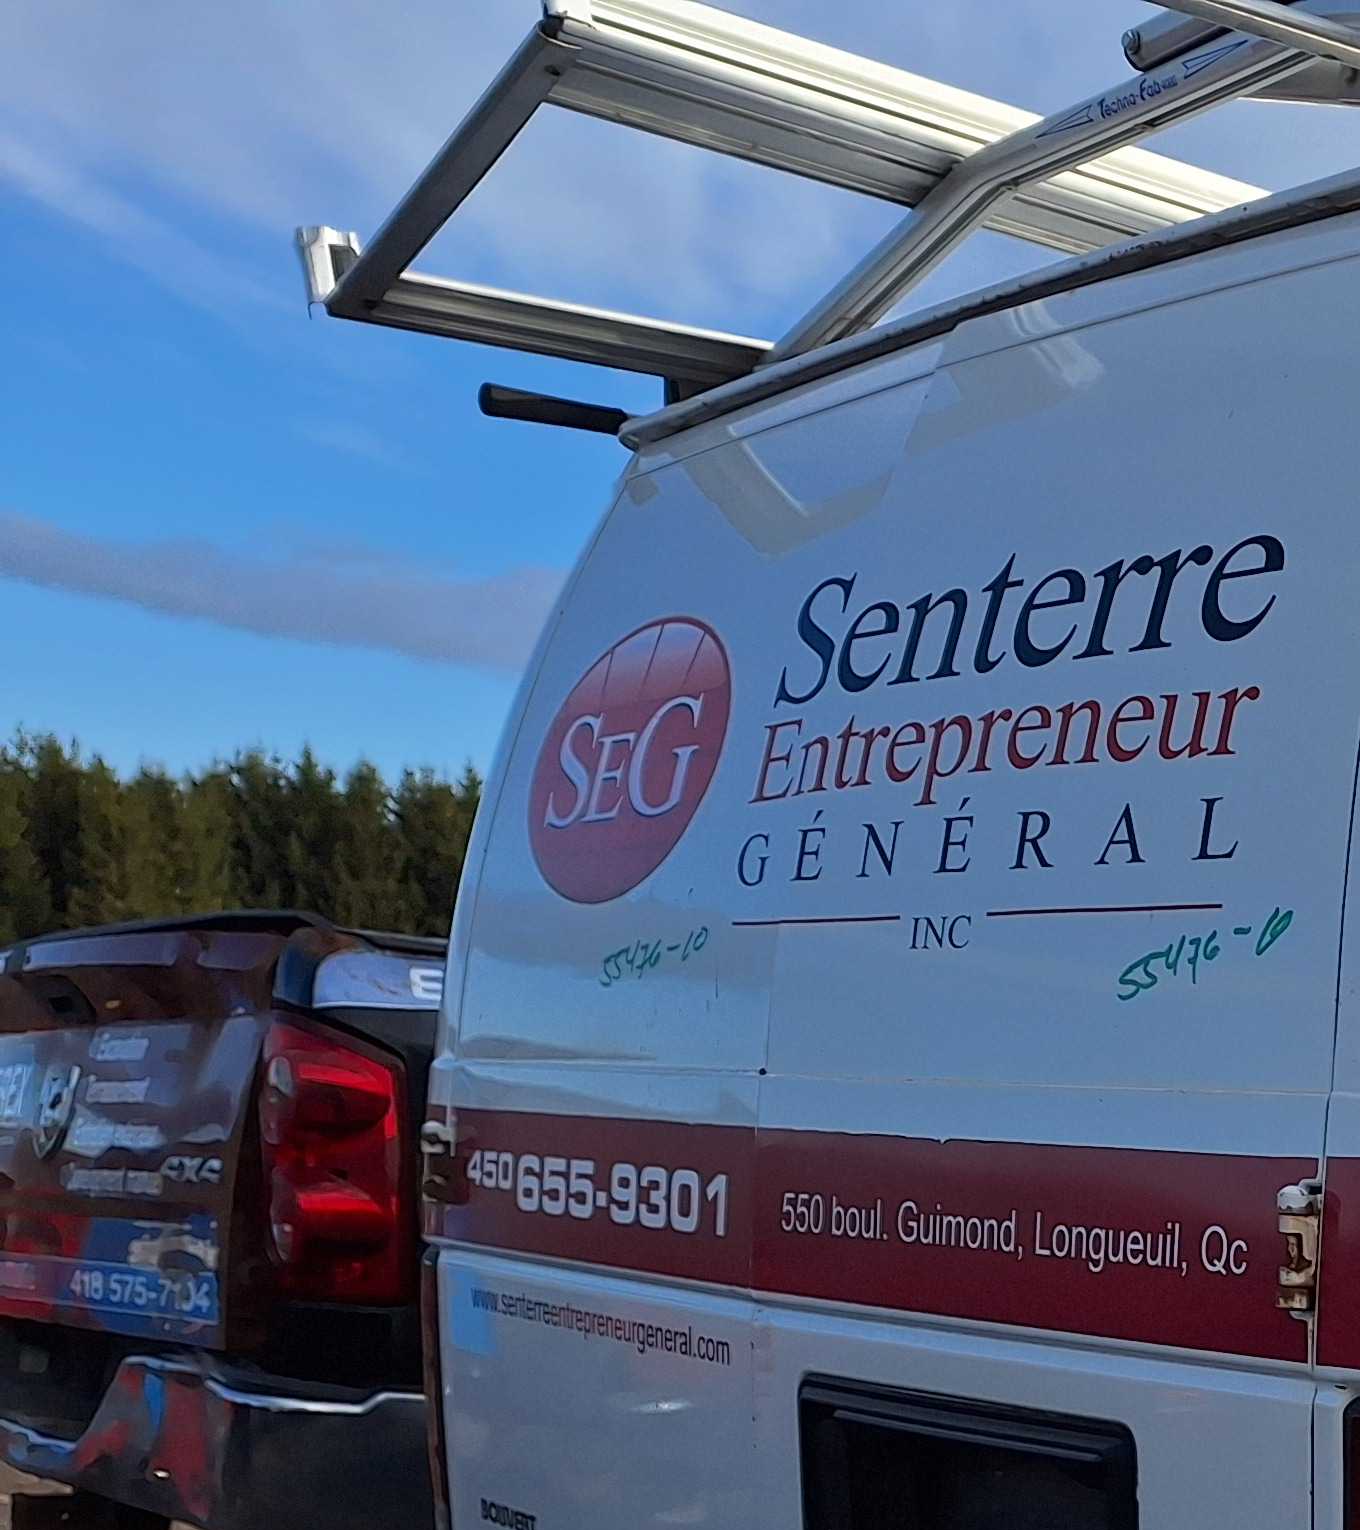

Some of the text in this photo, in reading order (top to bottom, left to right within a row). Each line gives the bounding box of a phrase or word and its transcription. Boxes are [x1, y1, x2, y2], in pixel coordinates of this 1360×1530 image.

[773, 534, 1285, 708] Senterre
[544, 694, 705, 831] SEG
[748, 684, 1261, 806] Entrepreneur
[737, 797, 1240, 887] GÉNÉRAL
[909, 914, 973, 951] INC
[466, 1148, 1249, 1278] 450 655-9301 550 boul. Guimond, Longueuil, Qc
[470, 1285, 731, 1367] www.senterreentrepreneurgeneral.com
